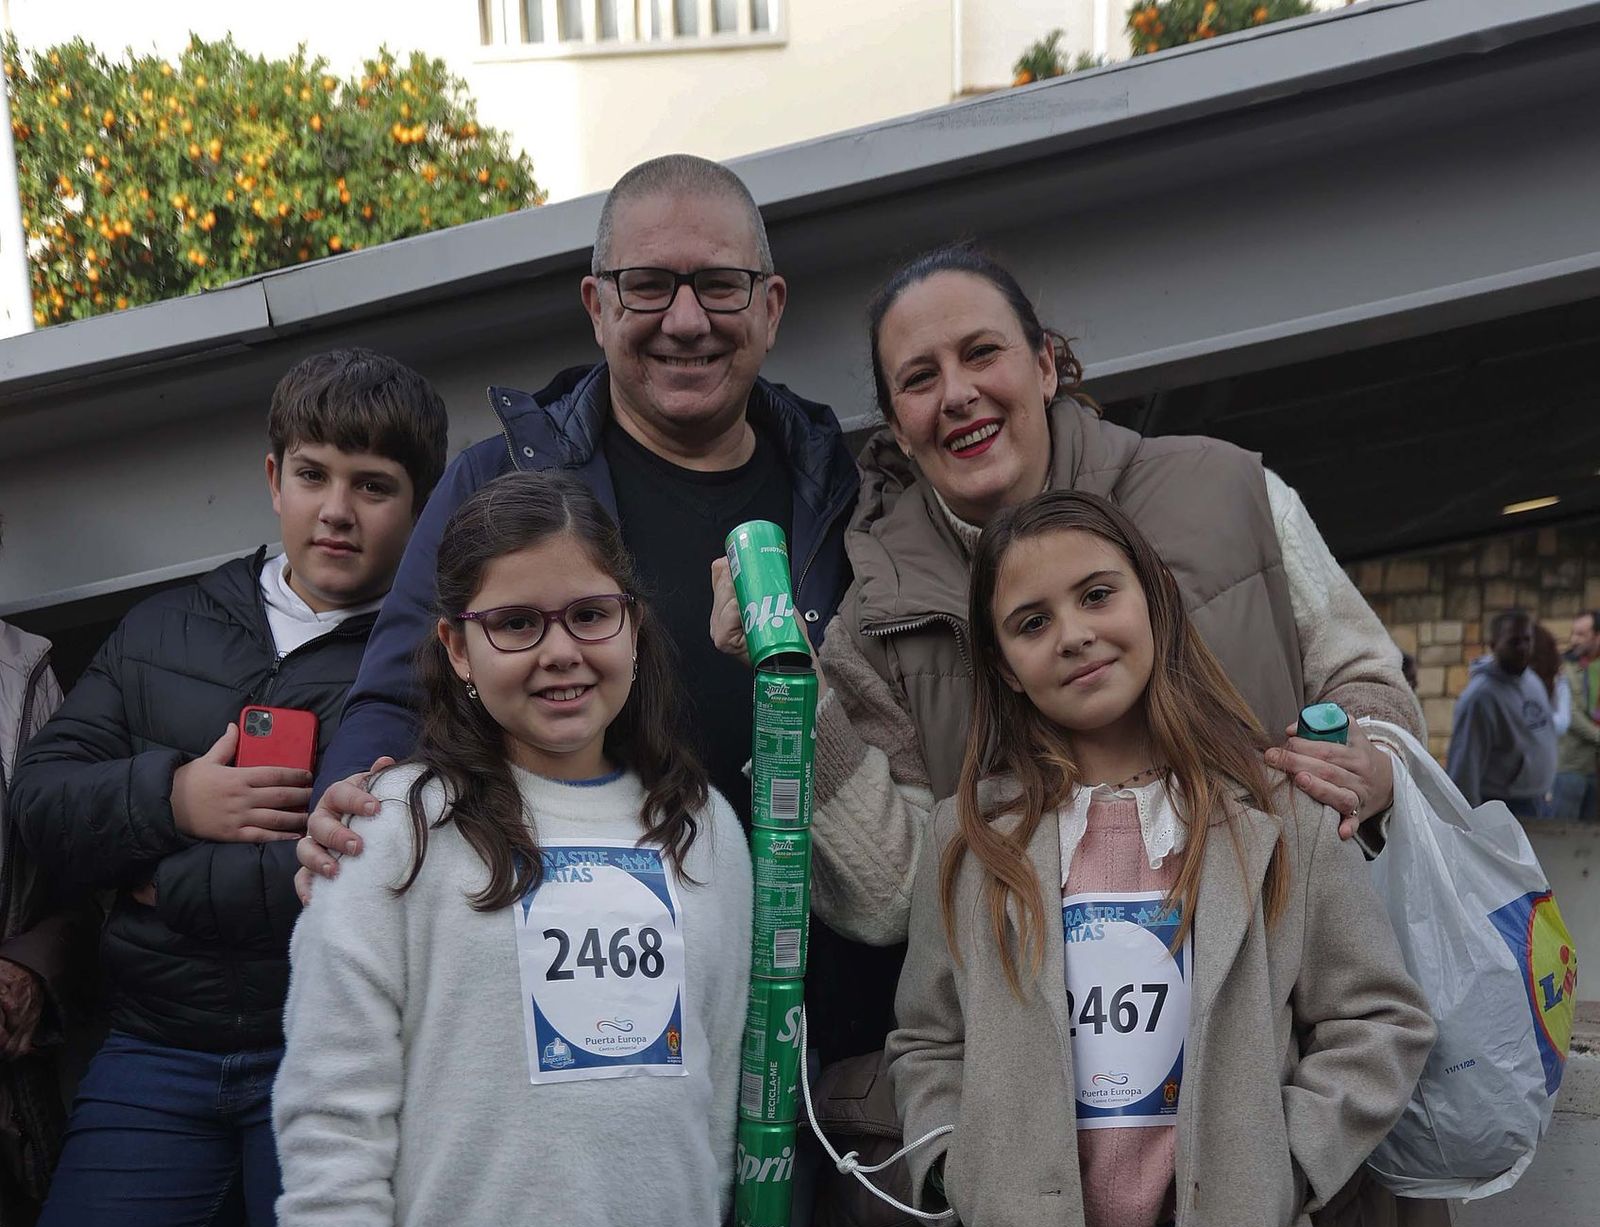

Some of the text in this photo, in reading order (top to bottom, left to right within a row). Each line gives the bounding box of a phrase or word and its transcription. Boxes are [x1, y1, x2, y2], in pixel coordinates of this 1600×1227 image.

[744, 593, 794, 634] ite
[544, 867, 594, 883] ATAS
[542, 927, 665, 981] 2468
[1538, 944, 1577, 1013] Li
[585, 1035, 647, 1045] Puerta Europa
[1444, 1059, 1476, 1075] 11/11/25
[1081, 1088, 1142, 1098] Puerta Europa
